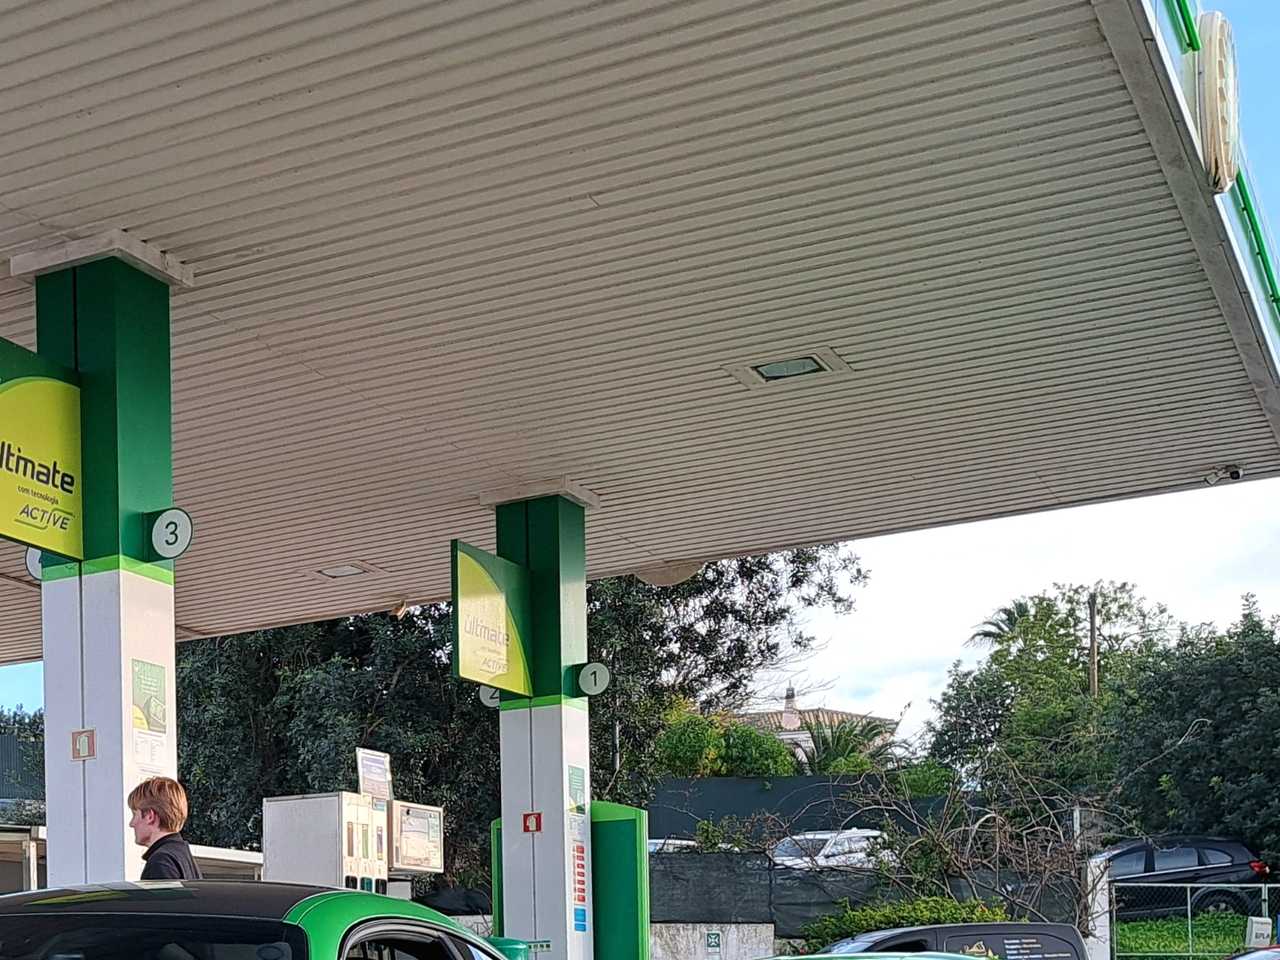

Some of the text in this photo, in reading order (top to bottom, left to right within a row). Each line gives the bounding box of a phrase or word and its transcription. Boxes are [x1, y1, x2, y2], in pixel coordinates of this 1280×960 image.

[17, 485, 59, 505] com tecnologia
[19, 504, 70, 531] ACTIVE
[164, 521, 179, 546] 3
[464, 616, 510, 648] ultimate
[482, 657, 508, 673] ACTIVE
[589, 670, 598, 687] 1
